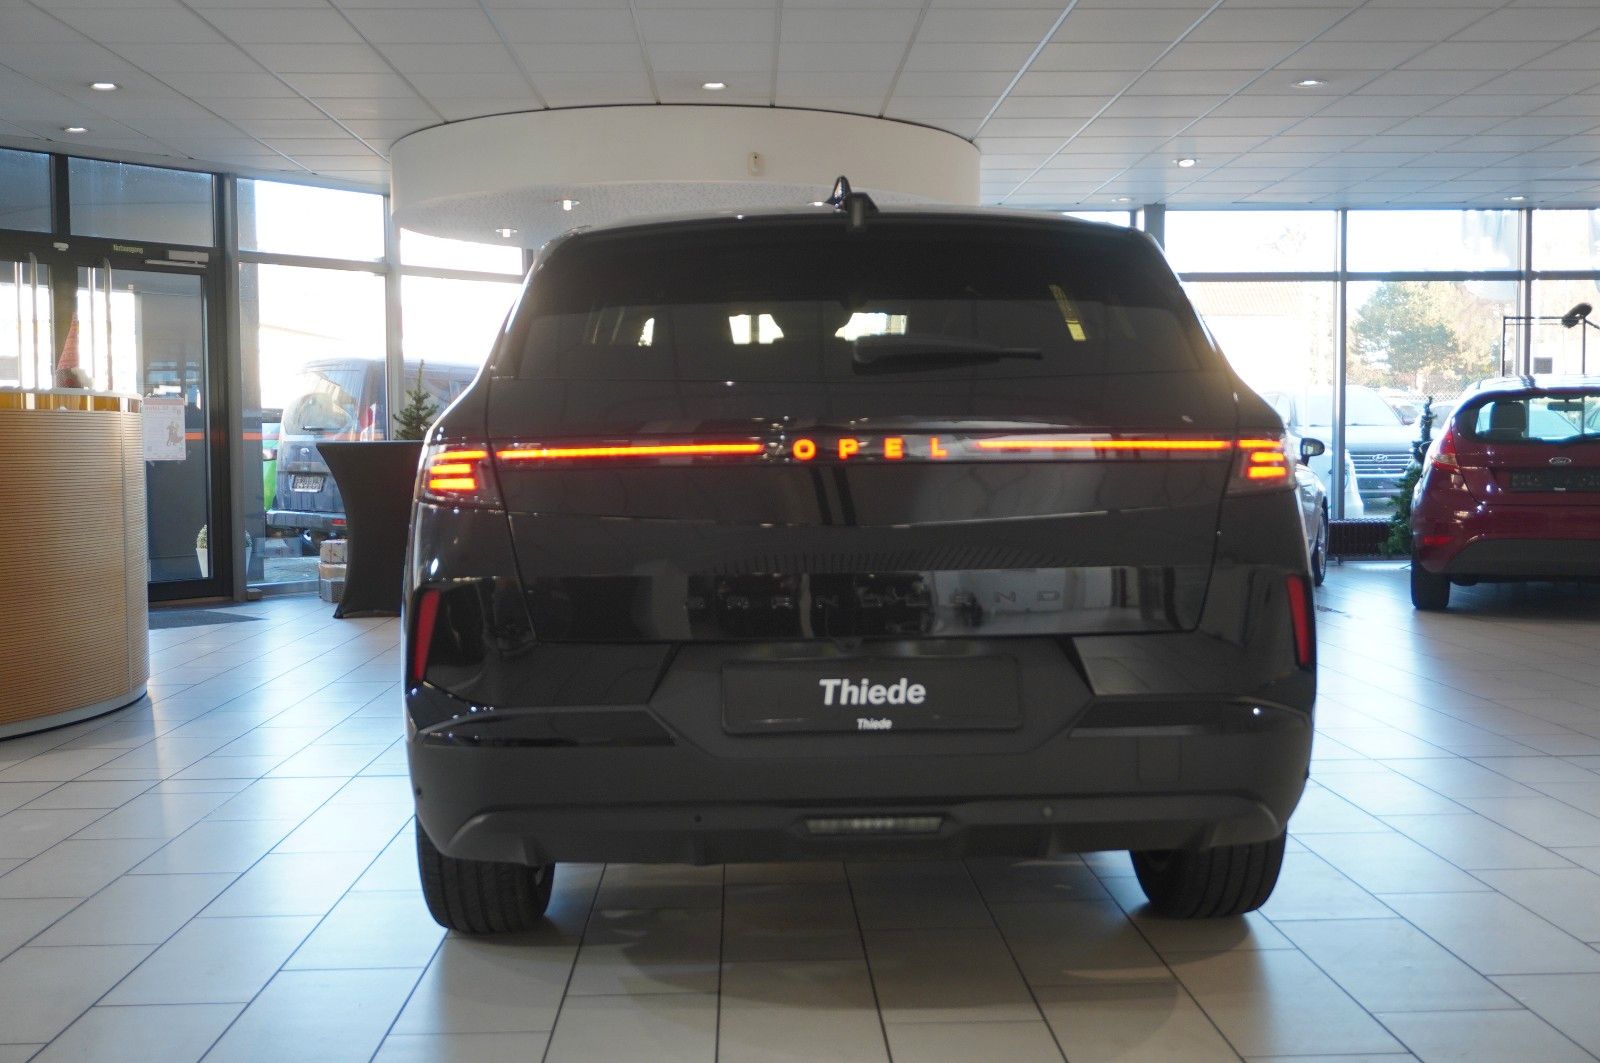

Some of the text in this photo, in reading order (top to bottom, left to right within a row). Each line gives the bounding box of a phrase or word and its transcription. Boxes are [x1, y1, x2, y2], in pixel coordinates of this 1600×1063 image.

[792, 437, 947, 460] OPEL
[819, 678, 926, 705] Thiede
[857, 718, 893, 730] Thiede
